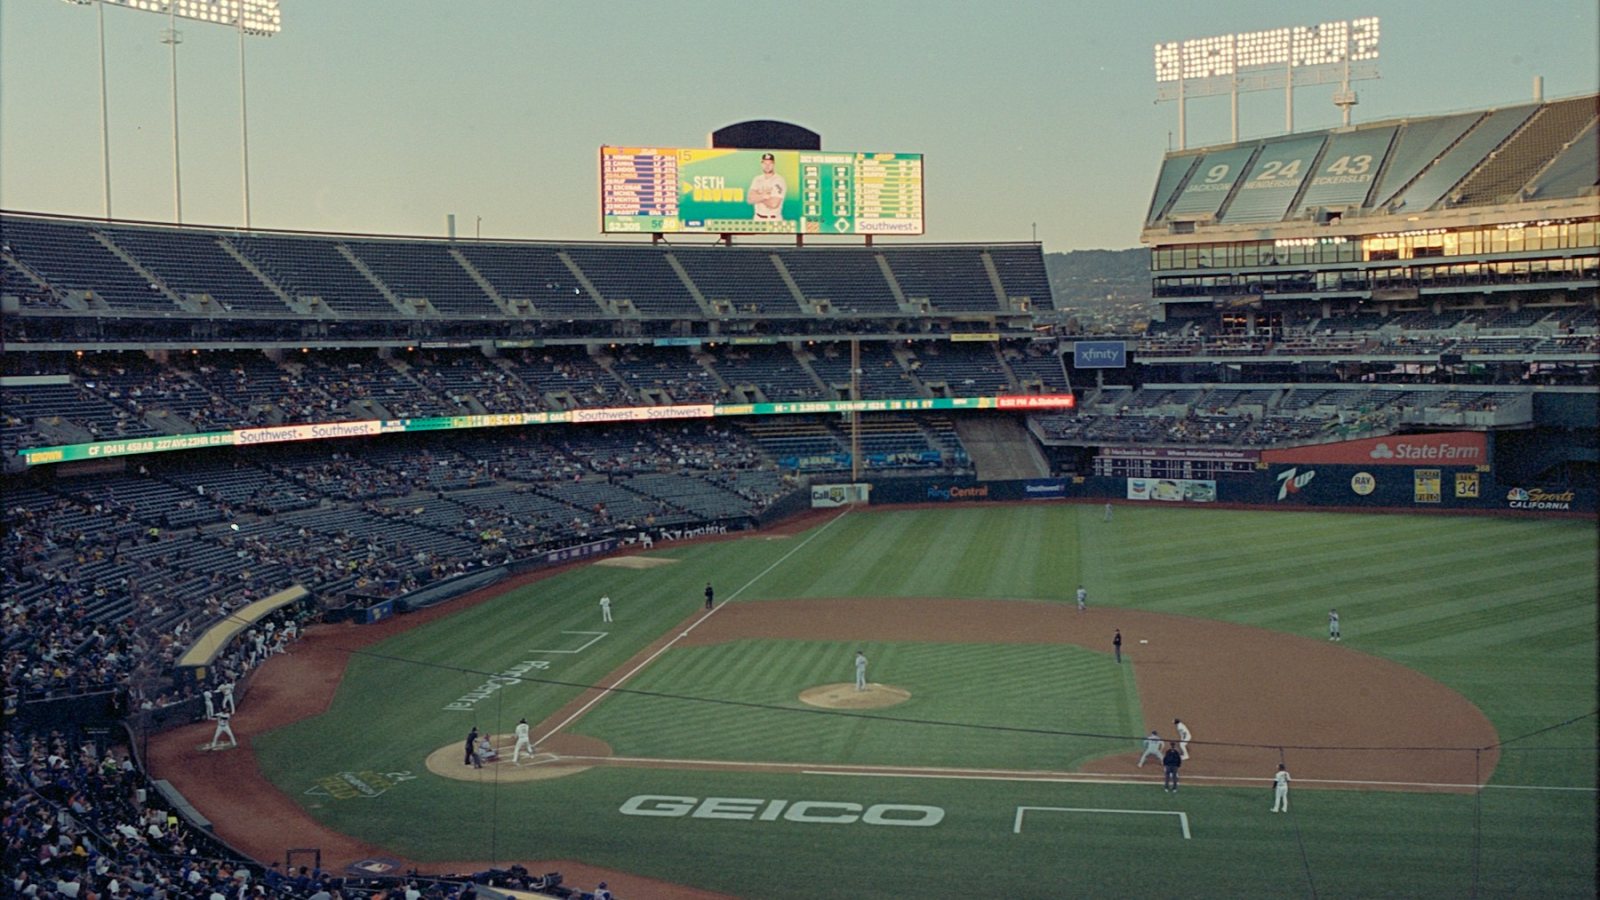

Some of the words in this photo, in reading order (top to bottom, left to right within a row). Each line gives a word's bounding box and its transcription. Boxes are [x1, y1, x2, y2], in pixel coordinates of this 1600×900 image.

[1256, 160, 1302, 181] 24
[1326, 154, 1372, 175] 43
[1205, 164, 1230, 183] 9
[694, 176, 724, 188] SETH
[1311, 174, 1374, 186] ECKERSLEY
[1185, 182, 1232, 193] JACKSON
[860, 221, 912, 231] Southwest
[1081, 348, 1119, 362] xfinity
[578, 410, 633, 420] Southwest
[647, 406, 701, 418] Southwest
[240, 429, 297, 442] Southwest
[311, 424, 369, 437] Southwest
[88, 446, 100, 456] CF
[1186, 450, 1223, 458] Relationships
[1354, 476, 1372, 486] RAY
[1458, 482, 1476, 495] 34
[813, 490, 829, 500] Call
[1527, 488, 1576, 503] Sports
[1509, 500, 1570, 510] CALIFORNIA
[618, 794, 945, 826] GEICO
